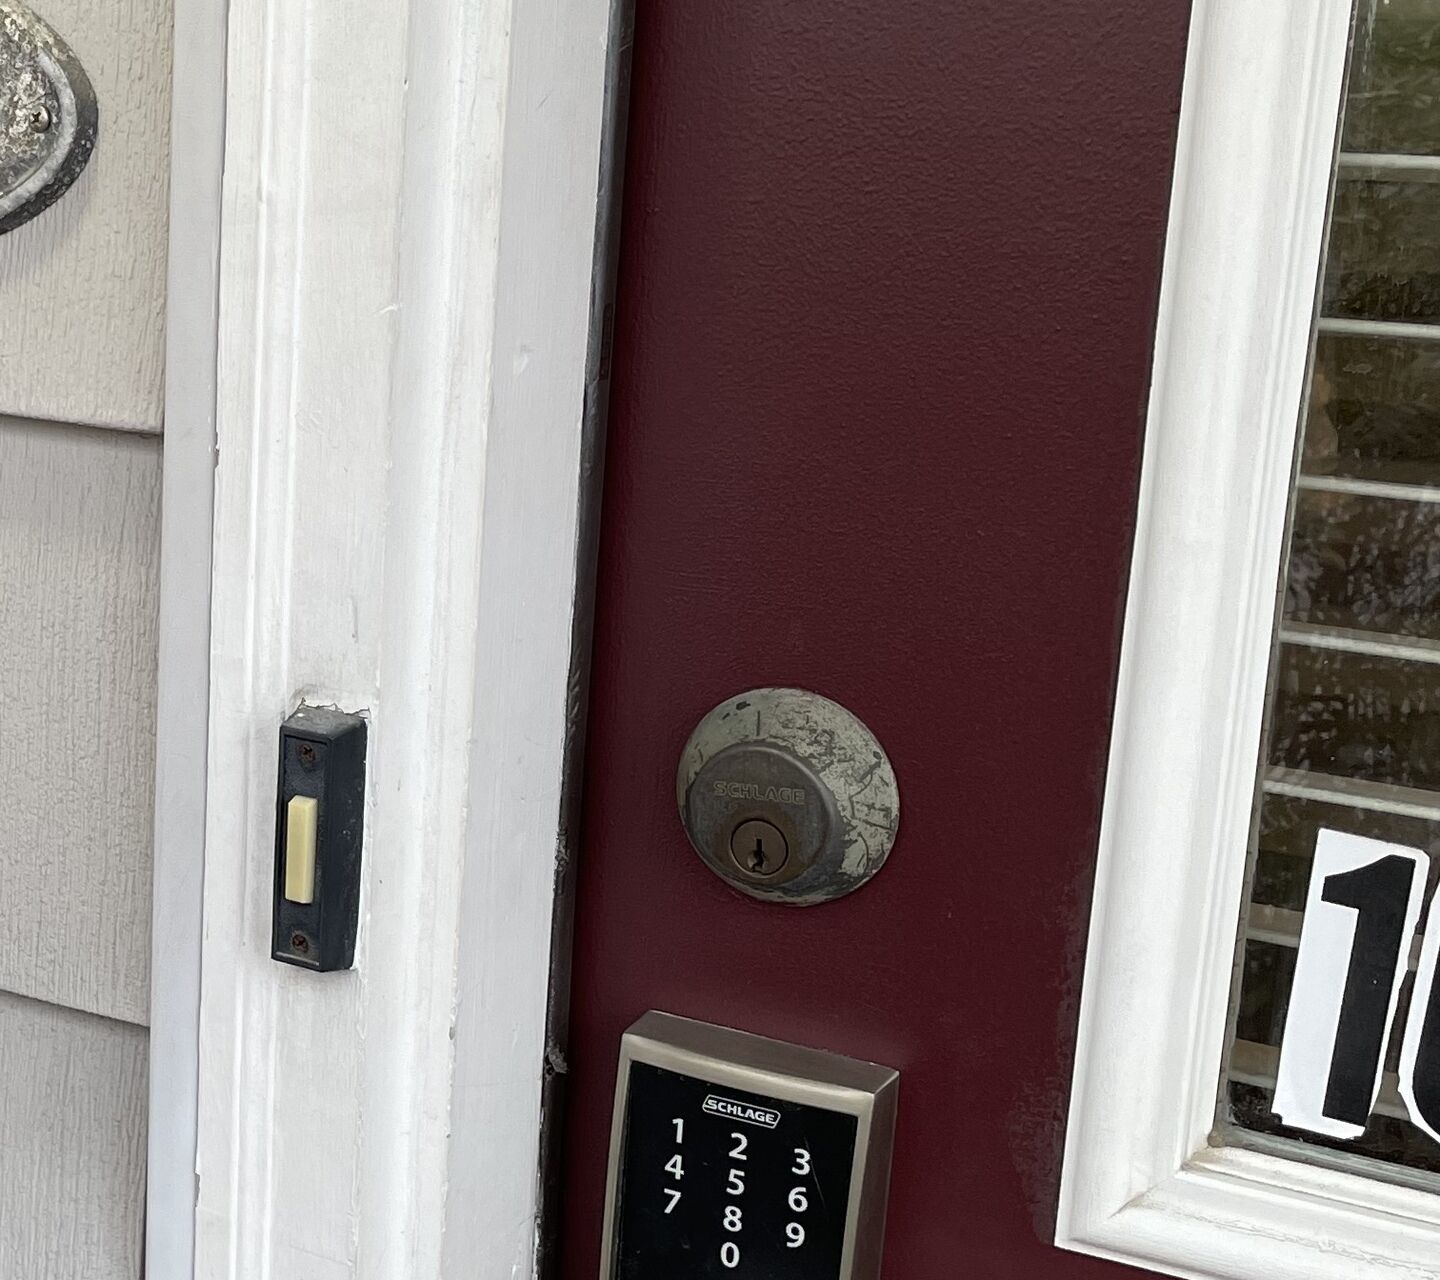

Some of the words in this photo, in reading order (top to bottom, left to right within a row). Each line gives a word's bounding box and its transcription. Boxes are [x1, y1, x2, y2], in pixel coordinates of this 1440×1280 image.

[714, 781, 806, 805] SCHLAGE
[1321, 853, 1440, 1130] 1
[706, 1099, 776, 1124] SCHLAGE
[672, 1118, 684, 1144] 1
[728, 1132, 748, 1160] 2
[664, 1154, 684, 1180] 4
[791, 1148, 811, 1175] 3
[726, 1169, 745, 1195] 5
[663, 1188, 682, 1214] 7
[787, 1186, 809, 1213] 6
[723, 1205, 743, 1232] 8
[785, 1222, 806, 1248] 9
[720, 1241, 740, 1268] 0
